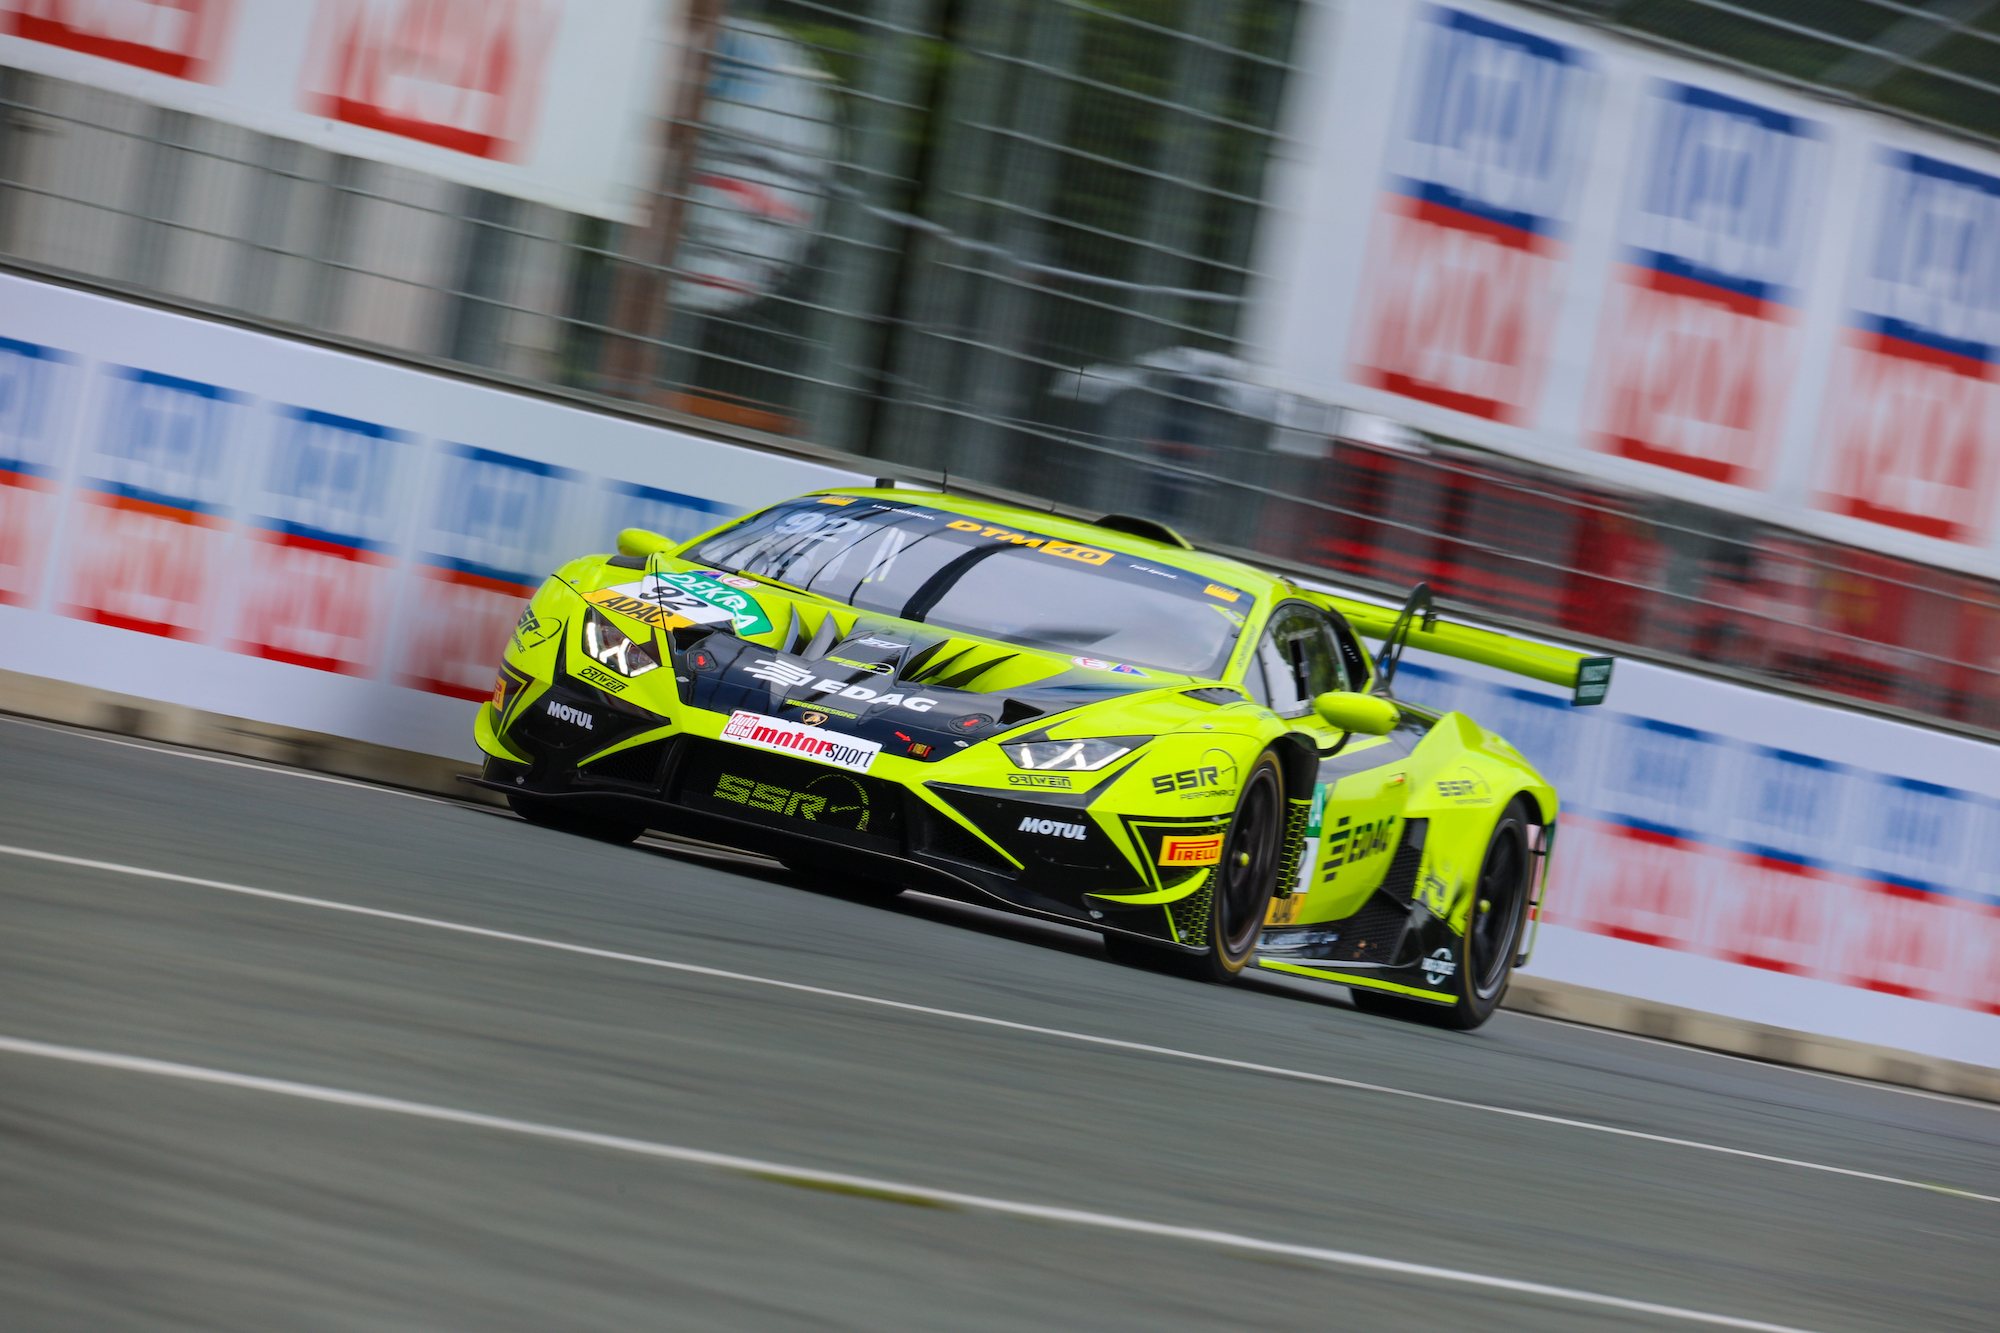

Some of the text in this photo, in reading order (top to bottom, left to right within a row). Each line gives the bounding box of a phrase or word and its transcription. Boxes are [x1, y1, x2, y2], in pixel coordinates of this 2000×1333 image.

[774, 512, 861, 544] 92
[946, 520, 1101, 562] DTM 40
[598, 596, 674, 624] ADAC
[639, 586, 709, 611] 92
[661, 573, 758, 630] DEKRA
[786, 698, 858, 720] SIEGERDESIGNS
[811, 678, 939, 713] EDAG
[547, 701, 594, 730] MOTUL
[729, 713, 758, 728] Auto
[726, 723, 752, 738] Bild
[750, 725, 875, 768] motorsport
[1151, 766, 1219, 795] SSR
[713, 773, 828, 821] SSR
[1018, 816, 1087, 841] MOTUL
[1167, 839, 1220, 861] PIRELLI
